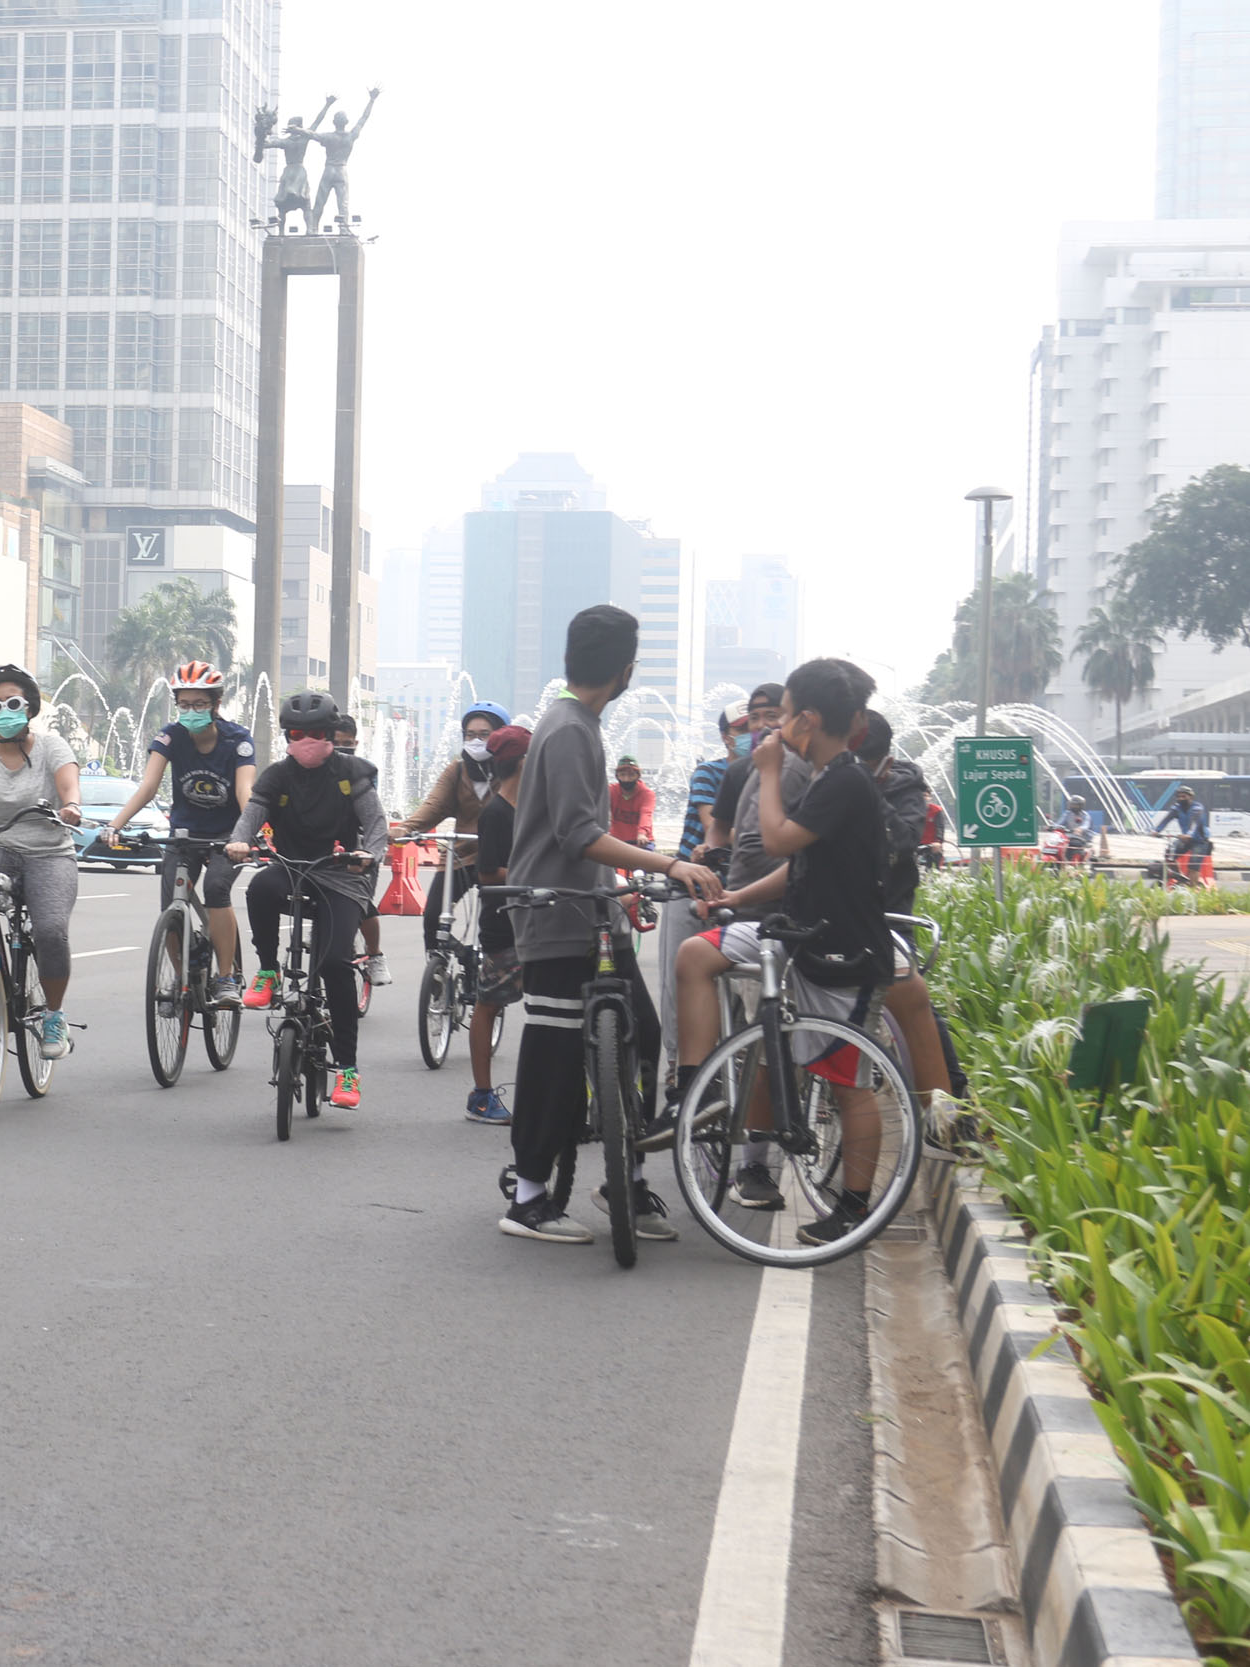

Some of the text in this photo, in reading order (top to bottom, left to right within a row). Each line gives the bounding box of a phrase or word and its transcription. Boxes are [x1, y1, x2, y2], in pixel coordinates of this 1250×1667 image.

[975, 749, 1017, 761] KHUSUS
[963, 769, 1027, 782] Lajur Sepeda
